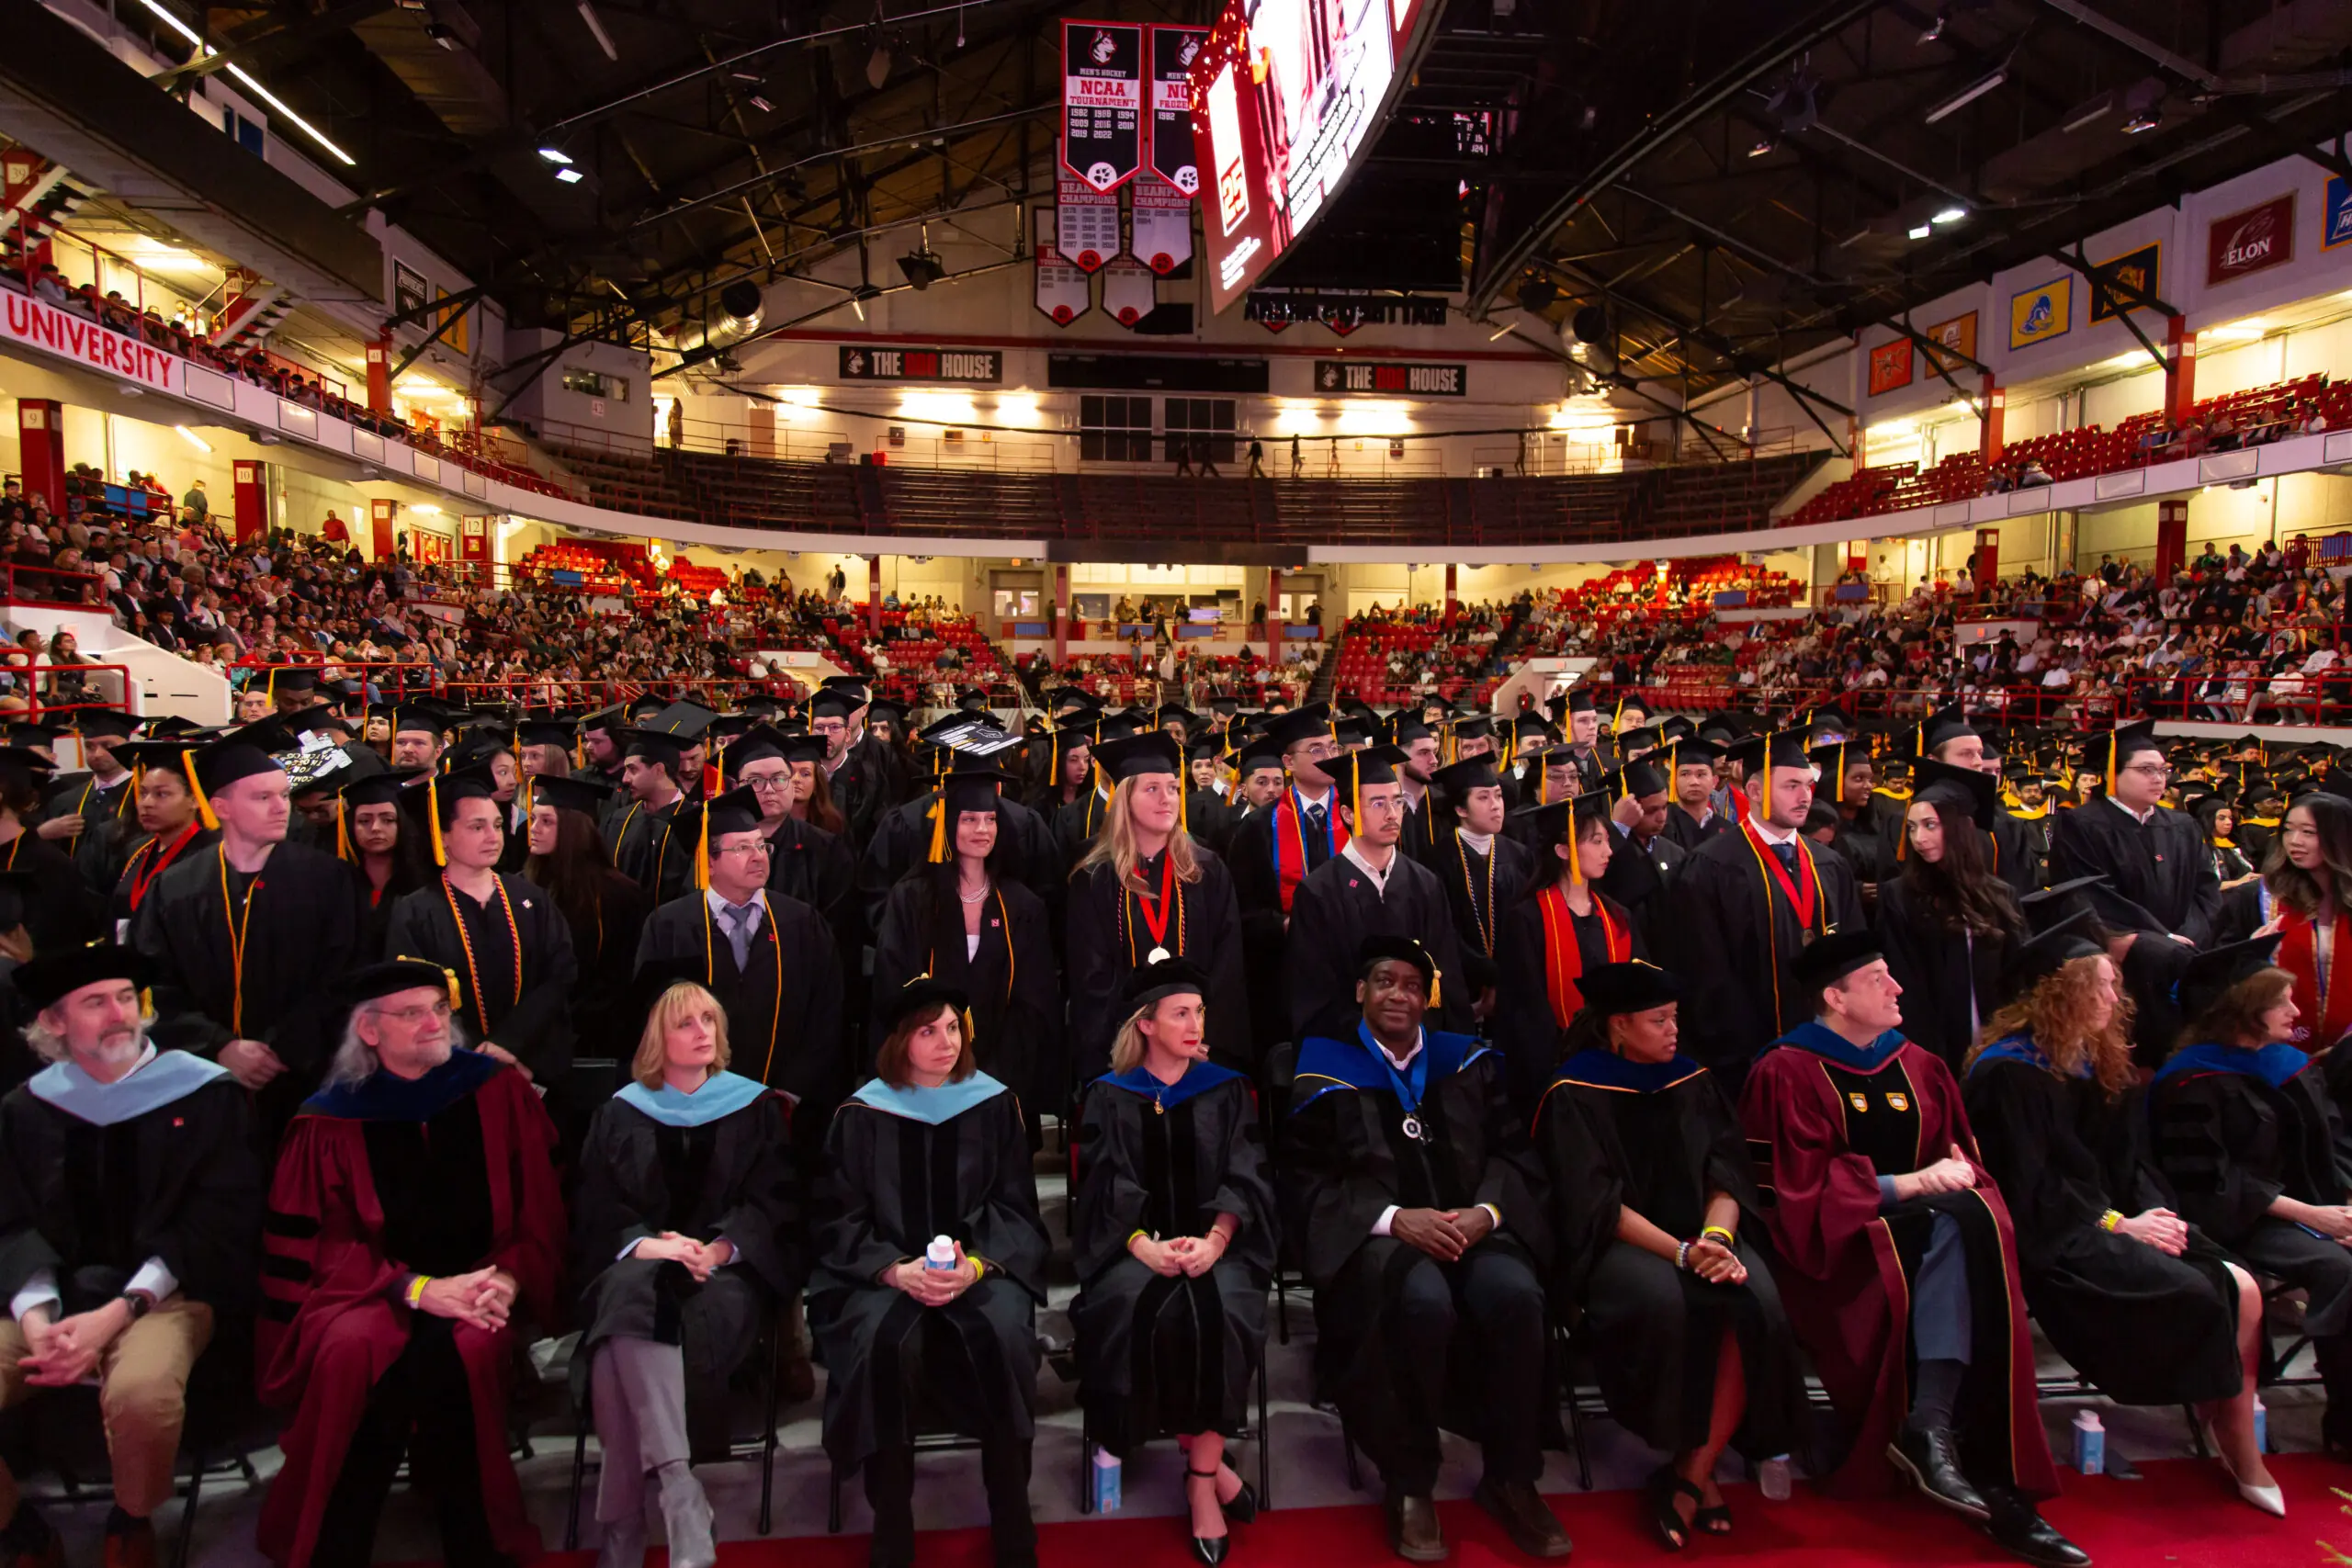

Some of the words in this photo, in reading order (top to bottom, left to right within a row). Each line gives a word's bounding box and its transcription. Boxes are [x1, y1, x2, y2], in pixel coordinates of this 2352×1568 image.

[1080, 80, 1126, 96] NCAA
[1069, 96, 1136, 107] TOURNAMENT
[1159, 99, 1189, 108] FROZE
[12, 167, 27, 179] 39
[1059, 194, 1117, 205] CHAMPIONS
[1134, 197, 1191, 208] CHAMPIONS
[2227, 239, 2271, 265] ELON
[6, 293, 174, 388] UNIVERSITY
[871, 351, 901, 376] THE
[942, 354, 993, 378] HOUSE
[1344, 366, 1373, 389] THE
[1375, 367, 1407, 390] DOG
[1409, 367, 1459, 392] HOUSE
[29, 412, 38, 425] 9
[240, 470, 251, 480] 10
[468, 521, 480, 533] 12
[1854, 543, 1864, 555] 19
